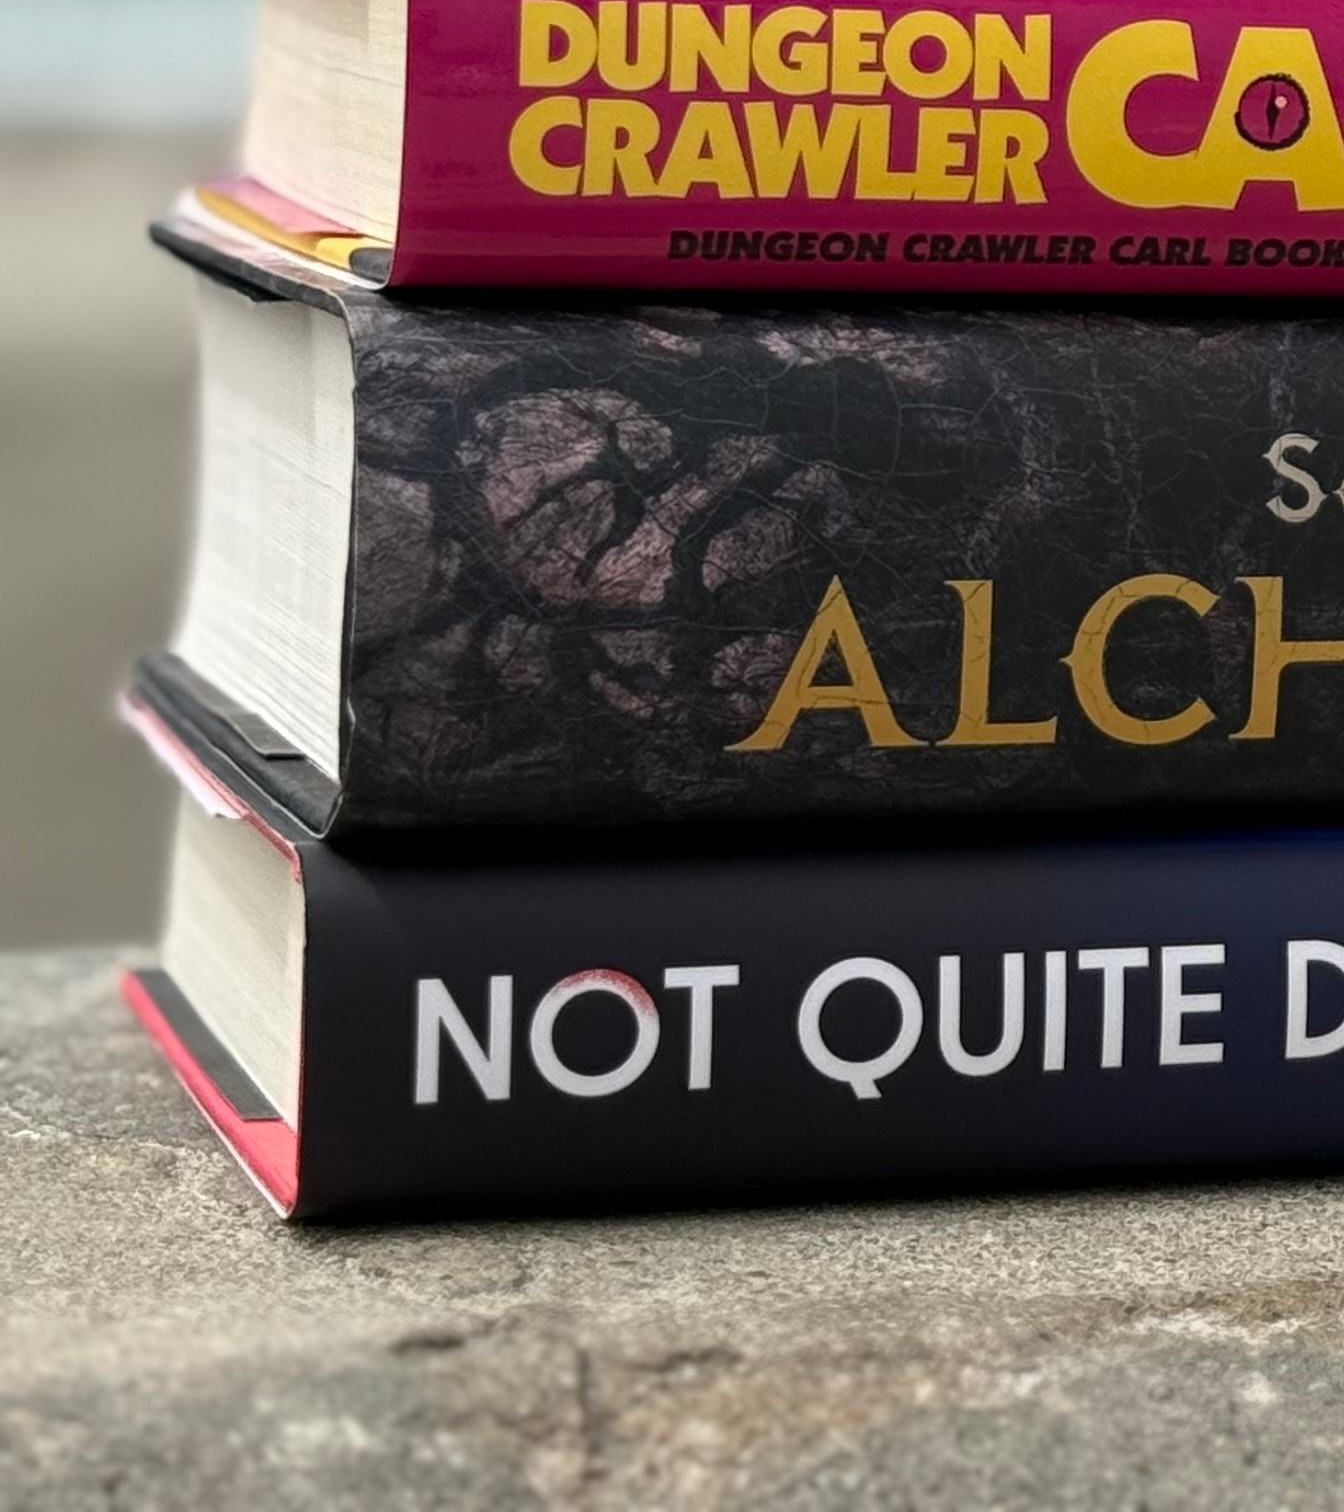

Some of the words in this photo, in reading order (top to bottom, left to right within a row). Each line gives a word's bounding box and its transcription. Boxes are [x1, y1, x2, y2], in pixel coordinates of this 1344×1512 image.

[509, 95, 1050, 204] CRAWLER
[667, 229, 888, 264] DUNGEON
[902, 234, 1096, 266] CRAWLER
[1109, 235, 1212, 268] CARL
[414, 964, 741, 1104] NOT
[798, 943, 1226, 1100] QUITE
